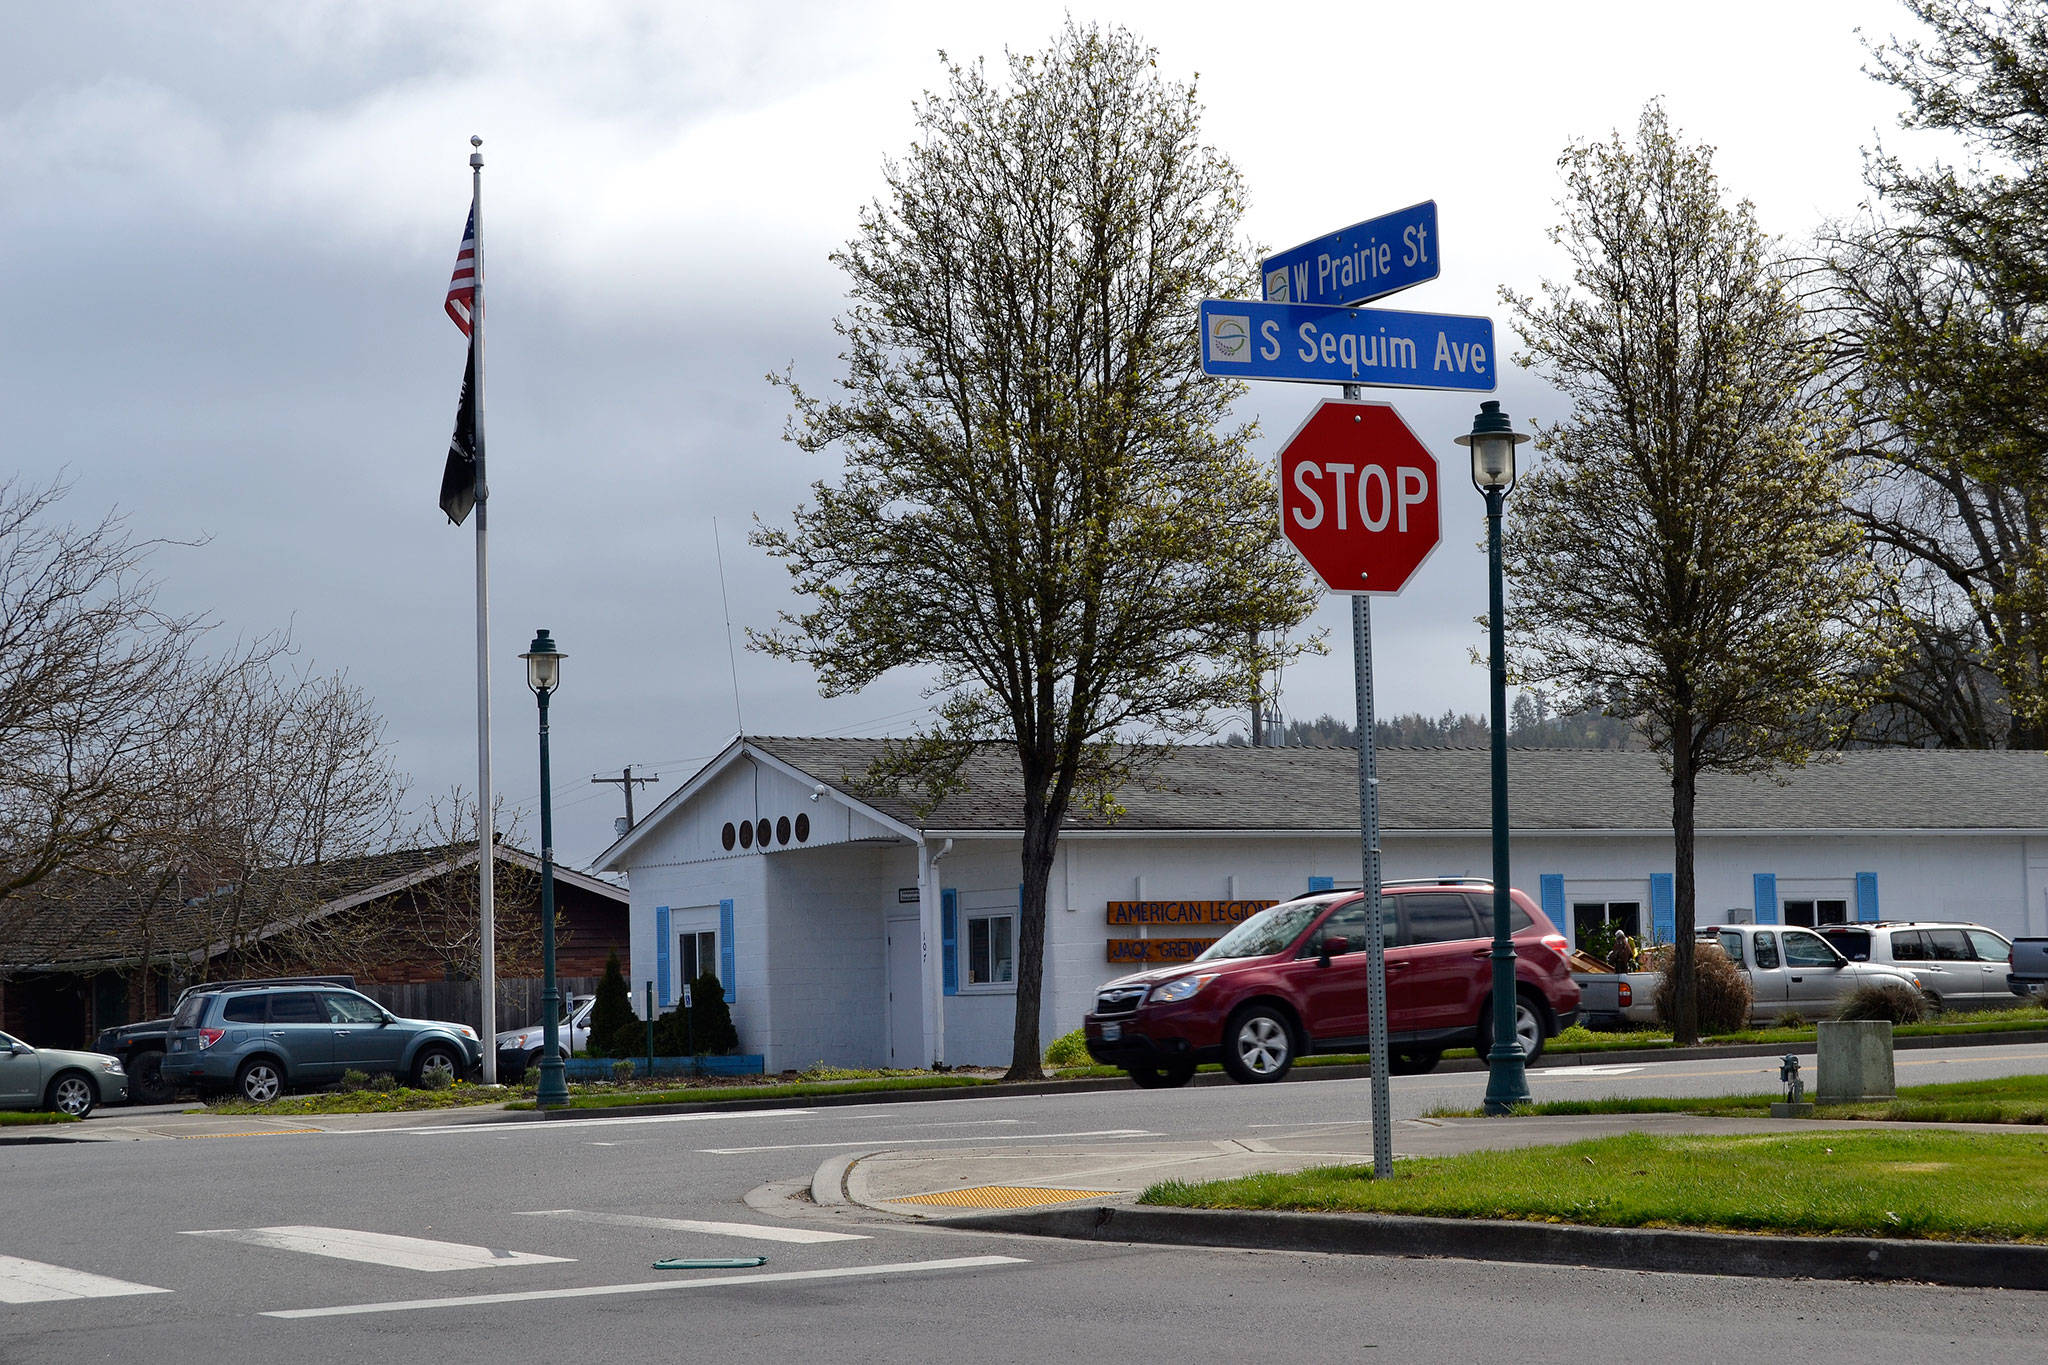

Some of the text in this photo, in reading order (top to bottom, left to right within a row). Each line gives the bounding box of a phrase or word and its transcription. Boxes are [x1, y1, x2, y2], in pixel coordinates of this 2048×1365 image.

[1293, 222, 1428, 302] W Prairie St
[1260, 320, 1487, 378] S Sequim Ave
[1292, 460, 1429, 533] STOP
[1115, 902, 1202, 923] AMERICAN
[1112, 941, 1151, 960] JACK
